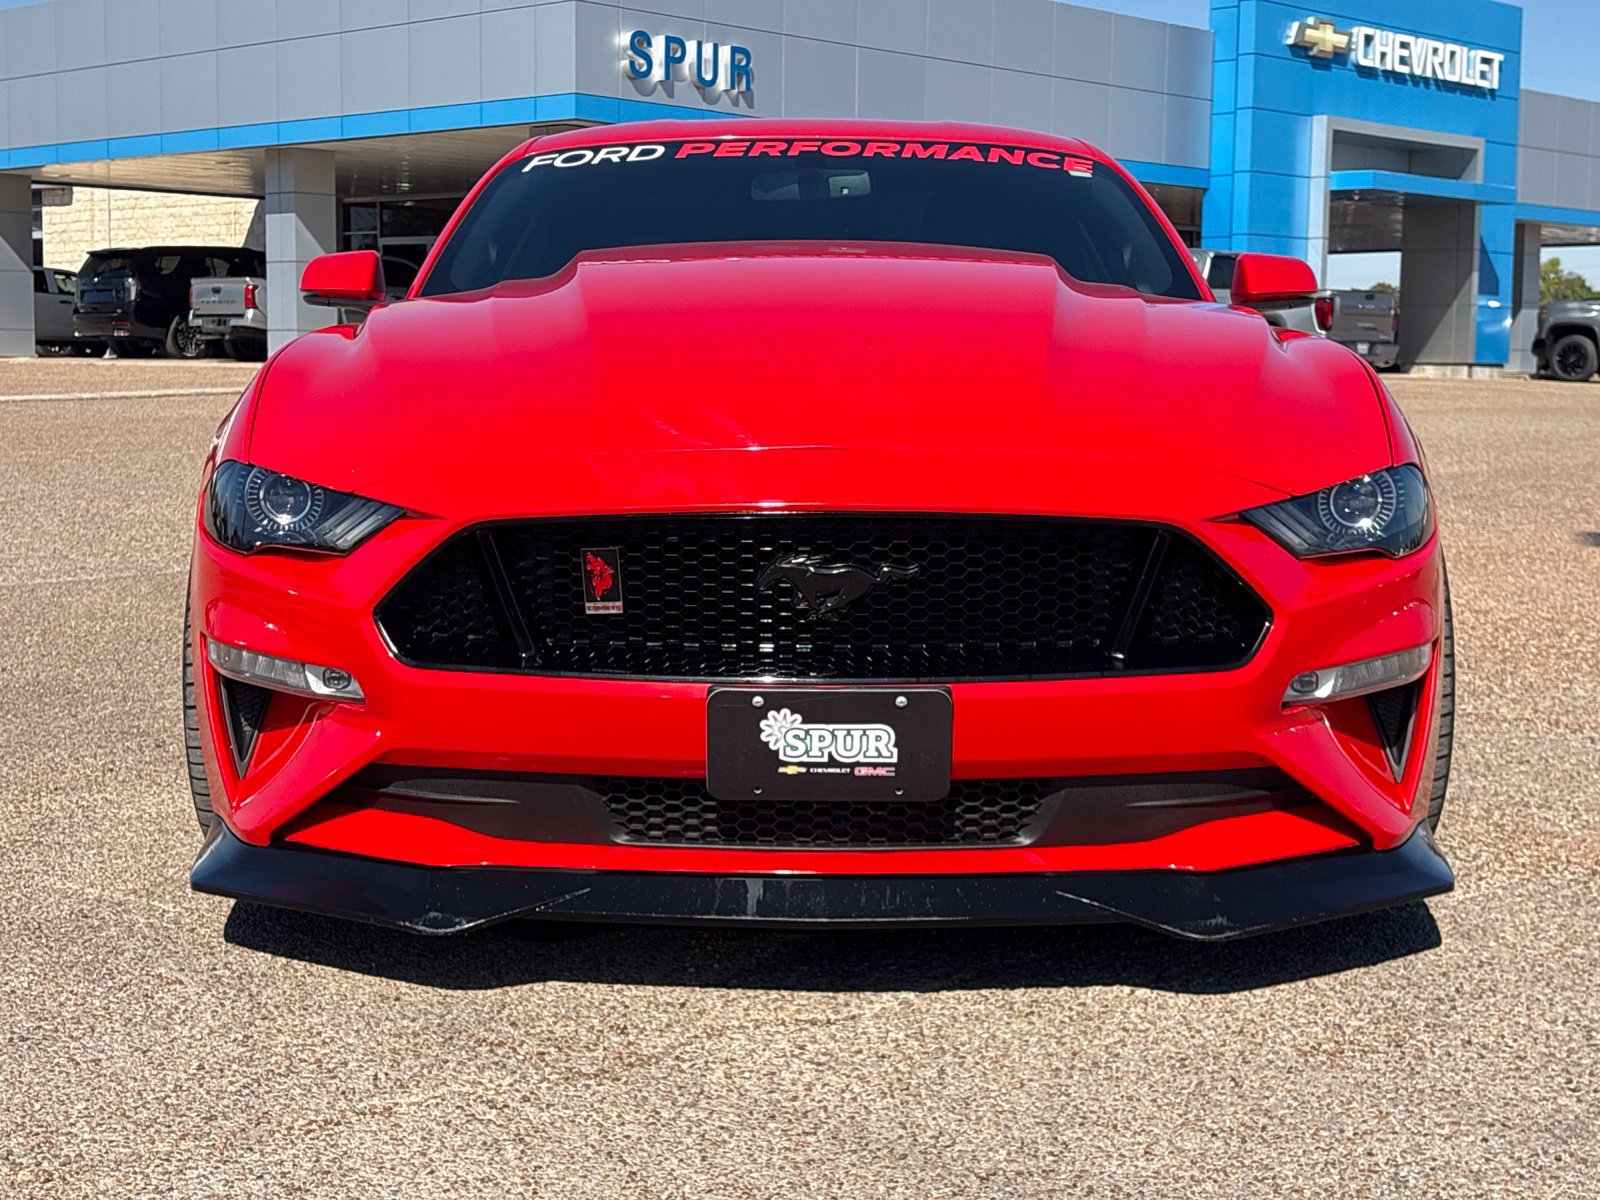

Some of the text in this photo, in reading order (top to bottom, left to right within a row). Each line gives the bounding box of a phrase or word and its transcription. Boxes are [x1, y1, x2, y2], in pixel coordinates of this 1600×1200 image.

[625, 29, 752, 92] SPUR
[1353, 26, 1504, 89] CHEVROLET
[521, 141, 1093, 177] FORD PERFORMANCE
[782, 727, 895, 760] SPUR
[854, 766, 896, 776] GMC
